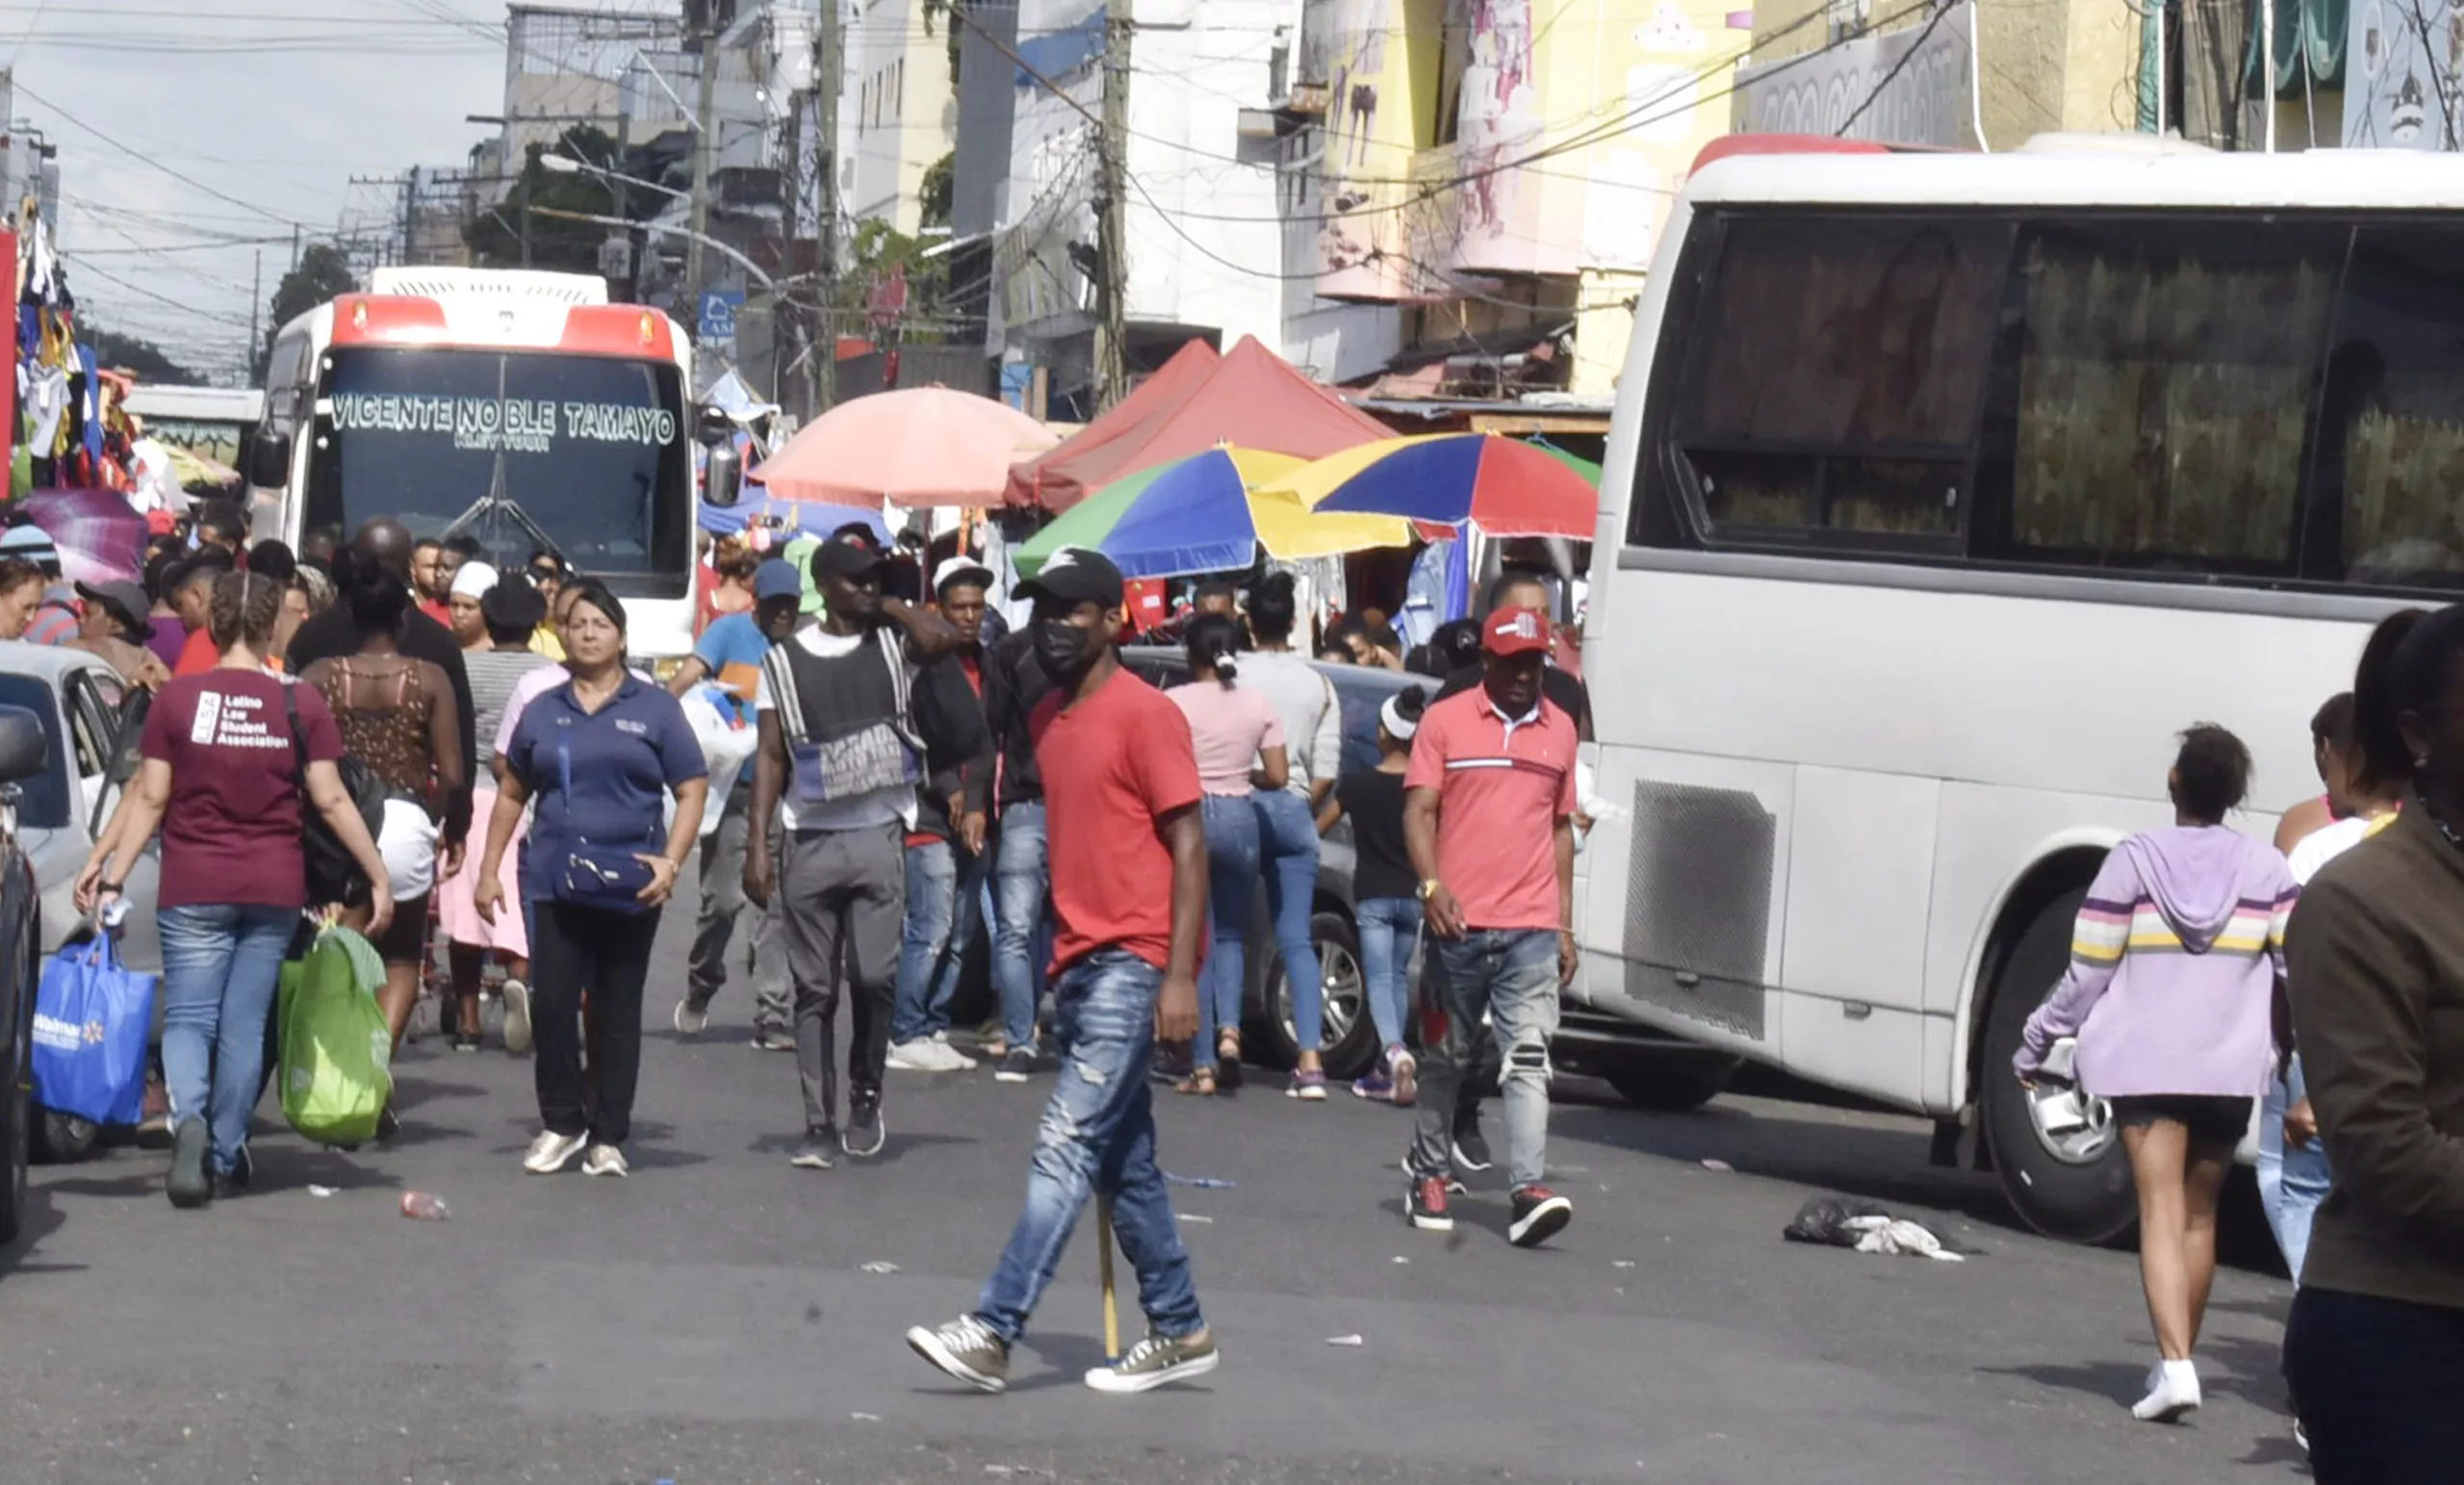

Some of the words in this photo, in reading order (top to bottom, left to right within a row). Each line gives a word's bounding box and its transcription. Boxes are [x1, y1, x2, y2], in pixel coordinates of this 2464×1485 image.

[330, 395, 454, 431] VICENTE
[564, 401, 676, 446] TAMAYO
[224, 694, 264, 709] Latino
[222, 707, 247, 721] Law
[220, 720, 268, 734] Student
[217, 732, 289, 749] Association
